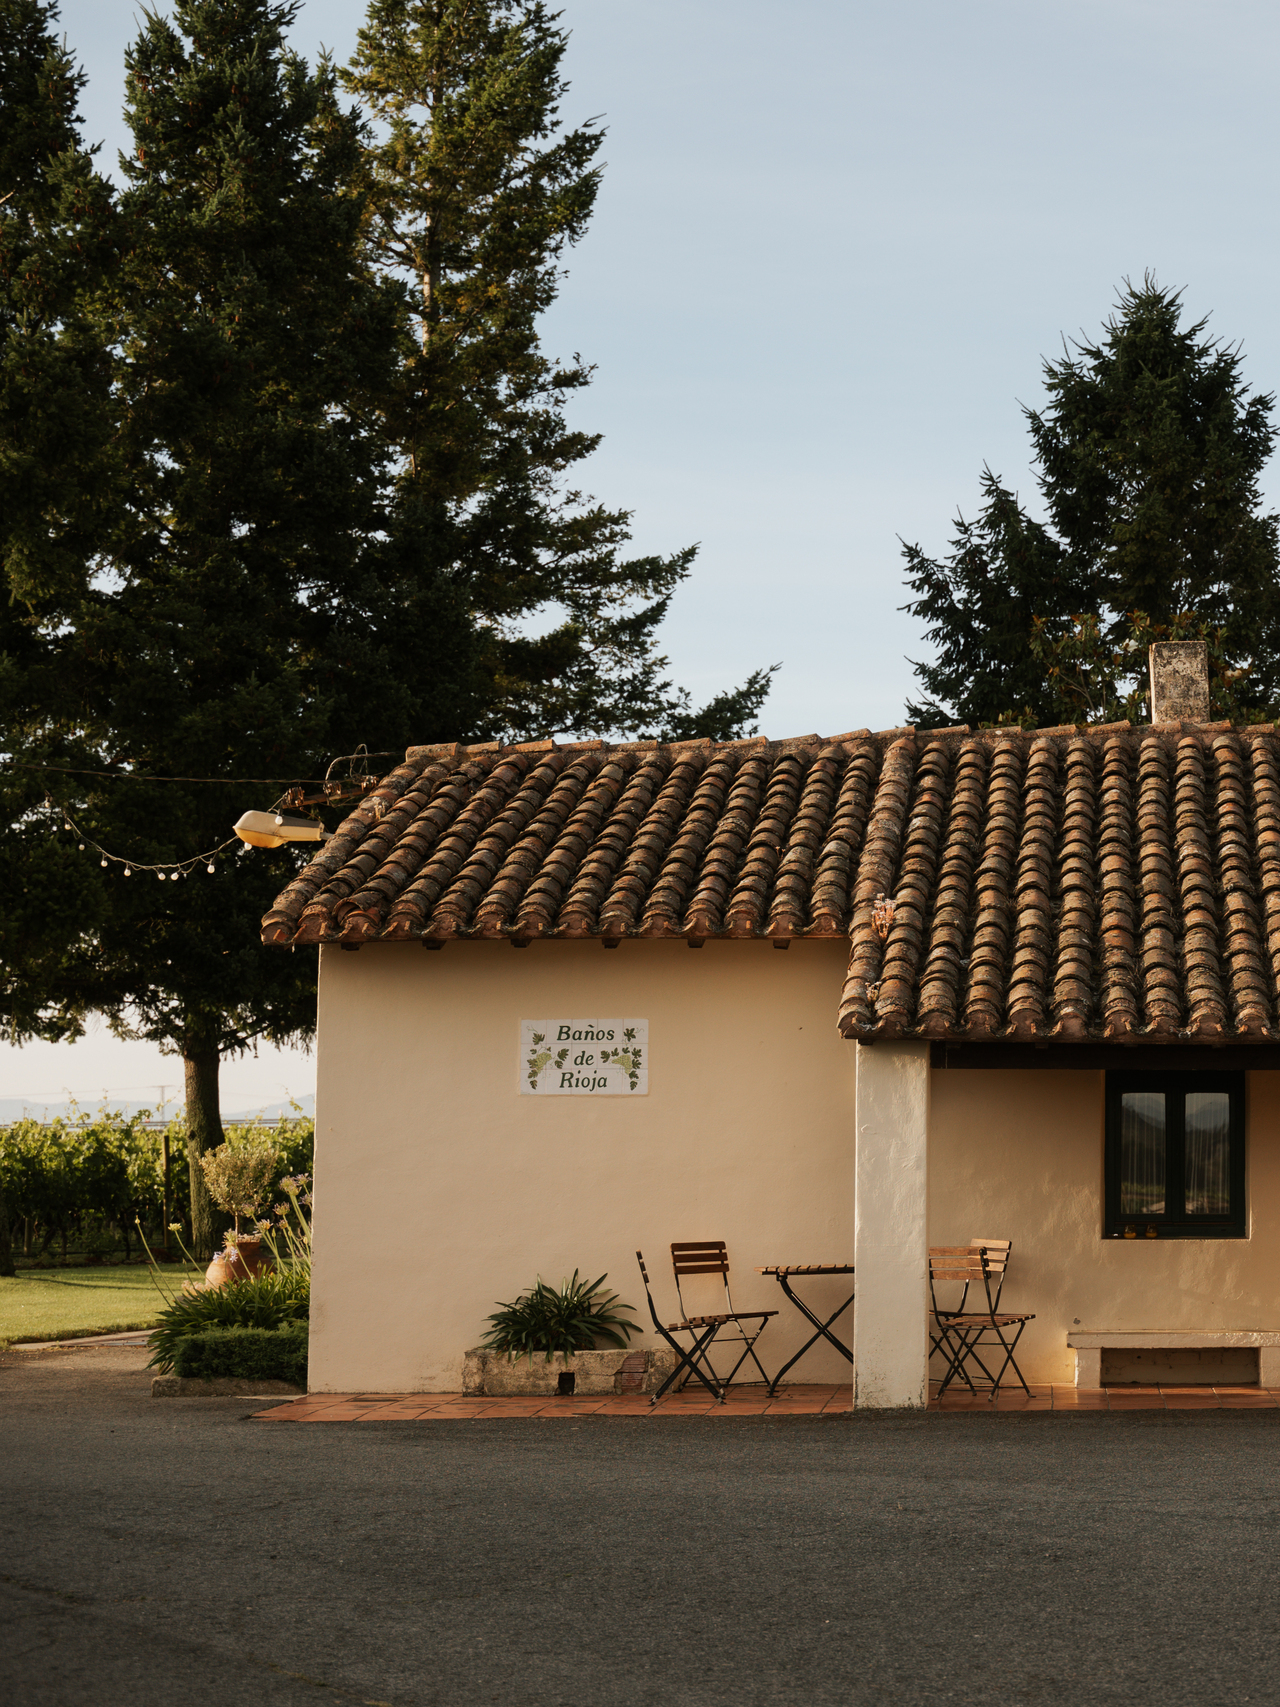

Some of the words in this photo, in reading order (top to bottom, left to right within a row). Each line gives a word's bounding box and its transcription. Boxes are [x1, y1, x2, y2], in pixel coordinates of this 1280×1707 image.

[556, 1024, 615, 1041] Baños
[573, 1050, 594, 1066] de
[559, 1069, 608, 1092] Rioja
